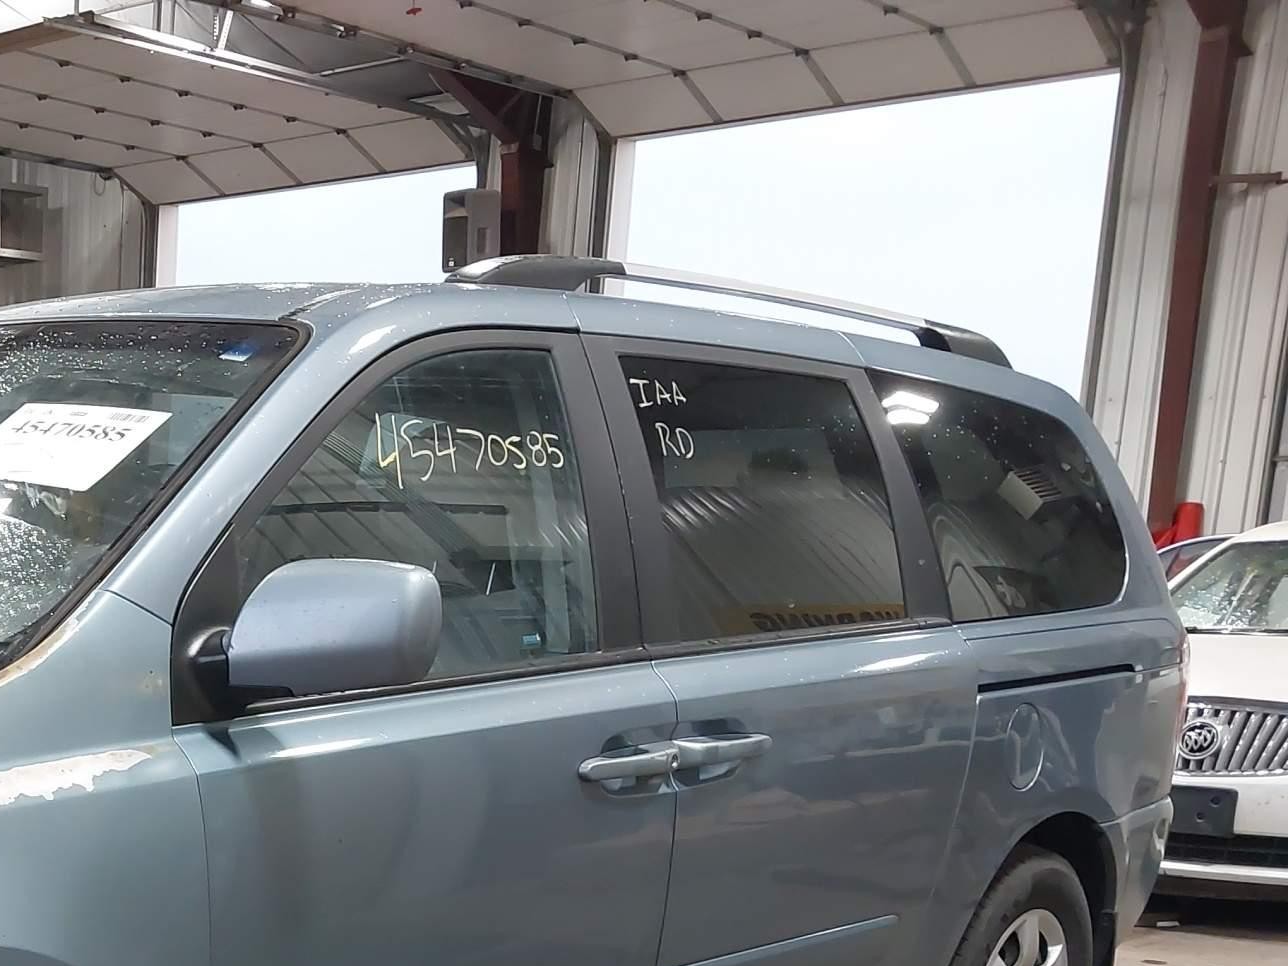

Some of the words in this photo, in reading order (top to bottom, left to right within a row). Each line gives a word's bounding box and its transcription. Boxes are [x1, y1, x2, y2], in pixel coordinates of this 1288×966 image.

[629, 378, 687, 408] IAA
[10, 419, 133, 442] 45470585
[655, 422, 694, 459] RD
[375, 412, 564, 490] 45470585
